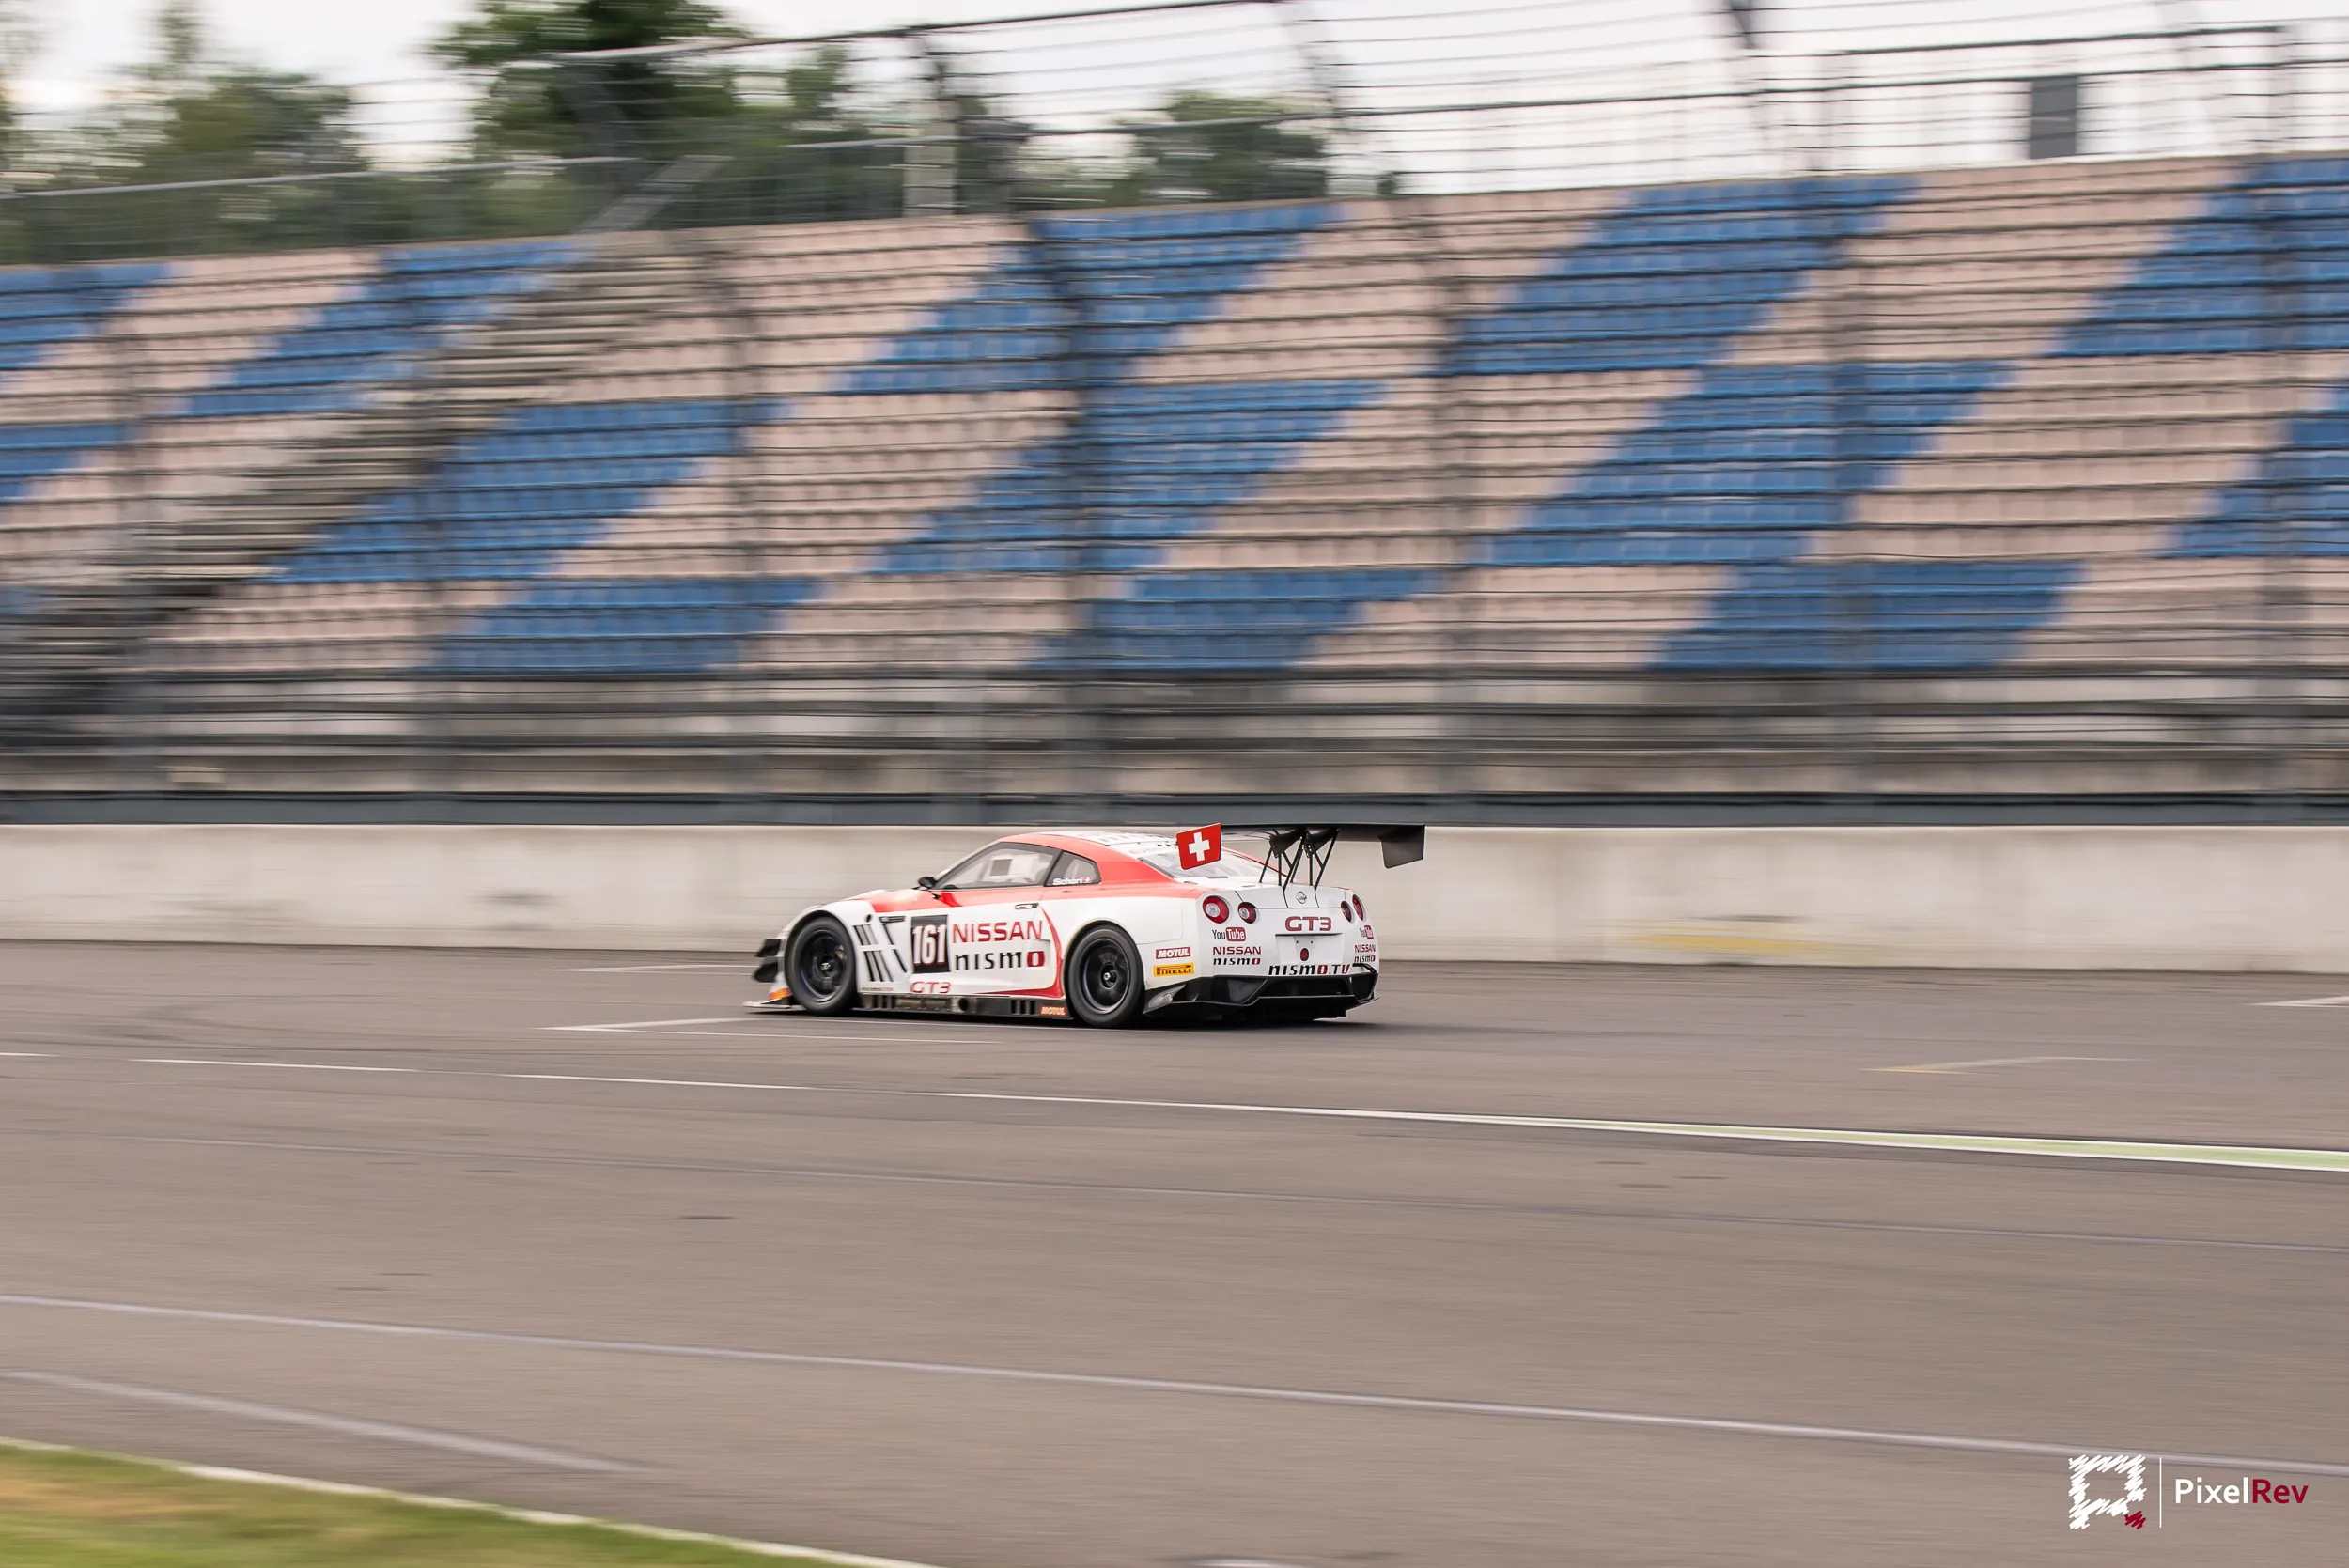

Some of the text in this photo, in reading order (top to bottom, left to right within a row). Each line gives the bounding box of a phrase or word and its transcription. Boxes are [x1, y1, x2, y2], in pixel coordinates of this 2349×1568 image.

[1284, 916, 1331, 931] GT3
[952, 920, 1042, 943] NISSAN
[1212, 927, 1246, 941] YouTube
[912, 924, 947, 964] 161
[1213, 946, 1261, 955] NISSAN
[1354, 944, 1376, 953] NISSAN
[1158, 948, 1190, 957] MOTUL
[955, 951, 1045, 970] nismo
[1213, 957, 1261, 966] nismo
[1156, 965, 1191, 974] PIRELLI
[910, 981, 951, 994] GT3
